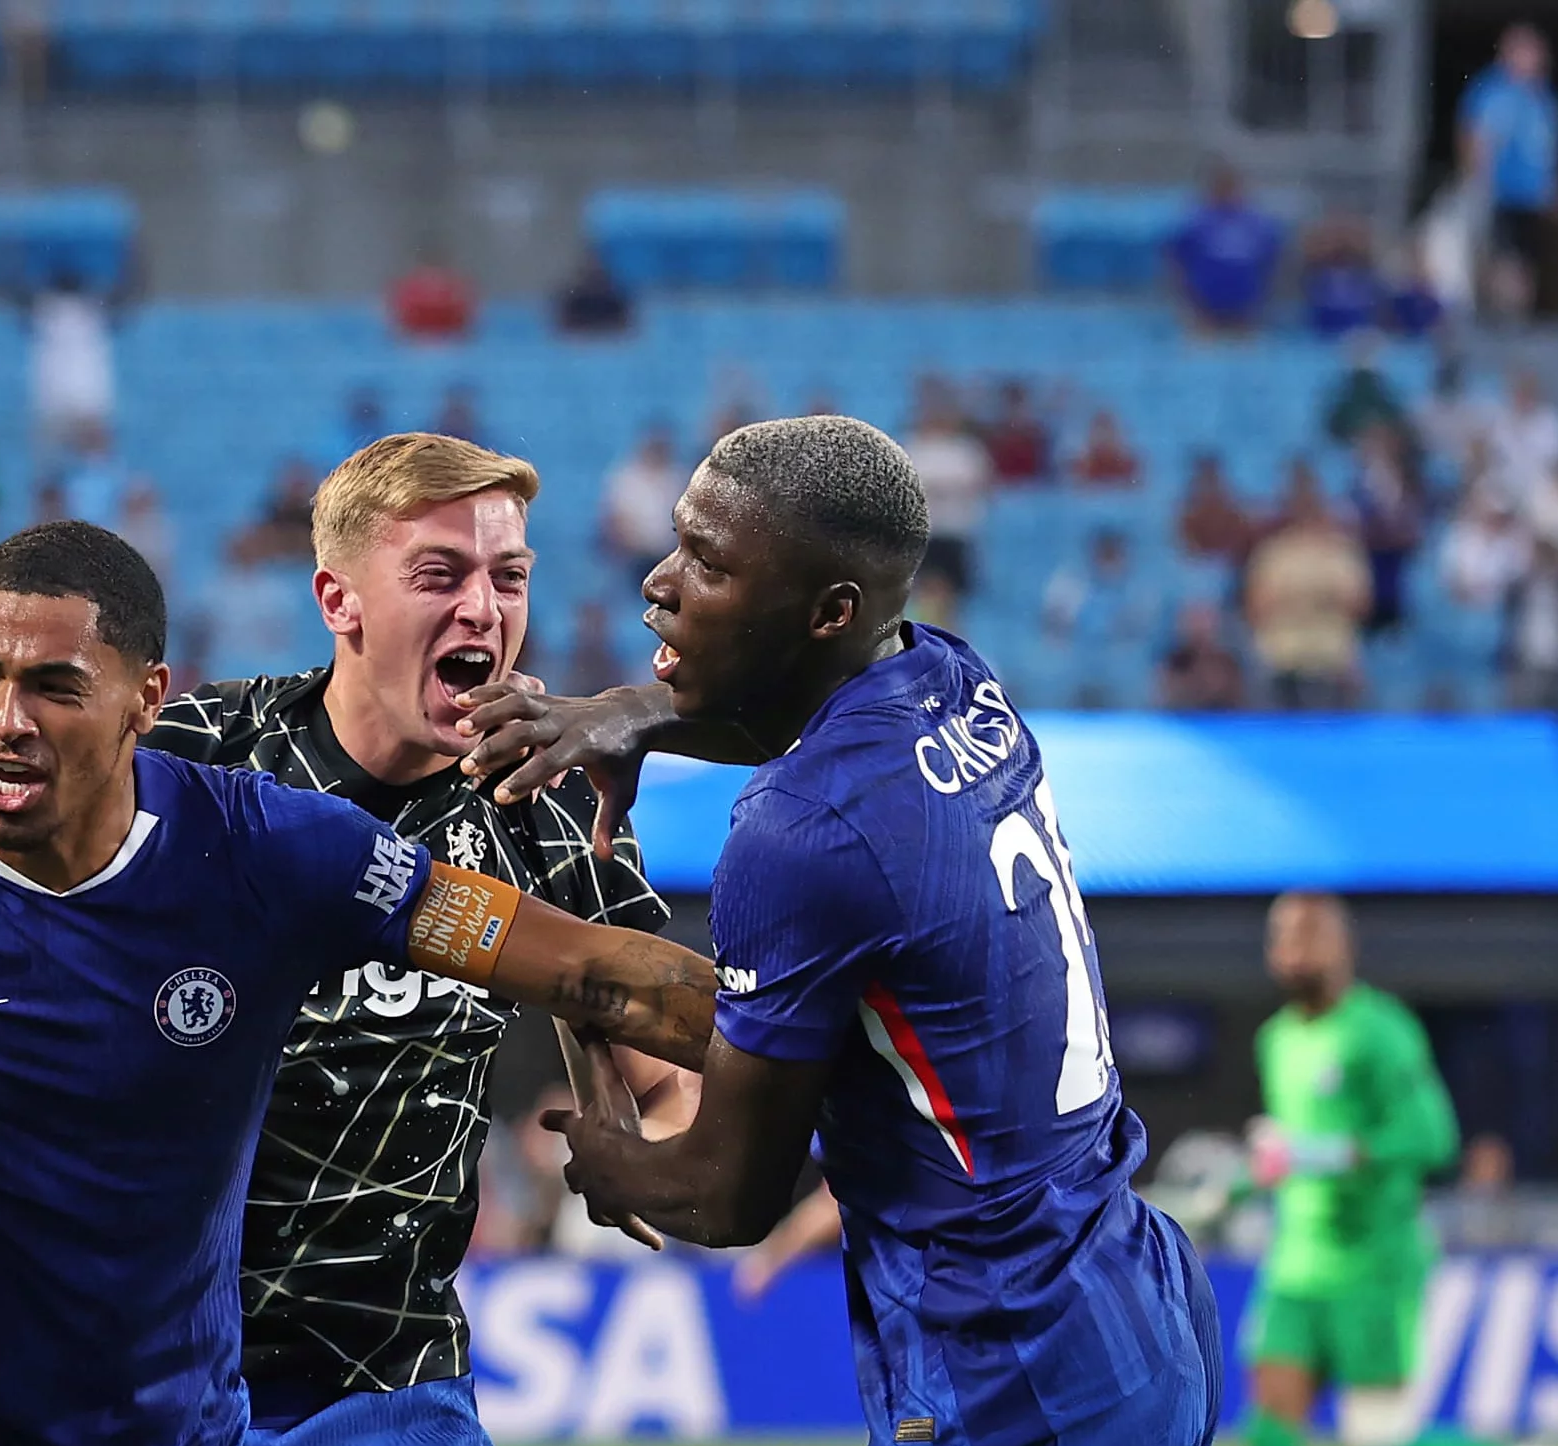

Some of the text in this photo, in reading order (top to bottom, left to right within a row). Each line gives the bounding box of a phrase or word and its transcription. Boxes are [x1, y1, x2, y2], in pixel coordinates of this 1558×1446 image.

[915, 679, 1020, 794] CAICED
[920, 695, 941, 716] FC
[354, 833, 397, 906] LIVE
[409, 876, 449, 950] FOOTBALL
[425, 882, 472, 956] UNITES
[450, 885, 494, 968] the World
[481, 918, 500, 949] FIFA
[167, 971, 220, 991] CHELSEA
[461, 1256, 728, 1440] SA
